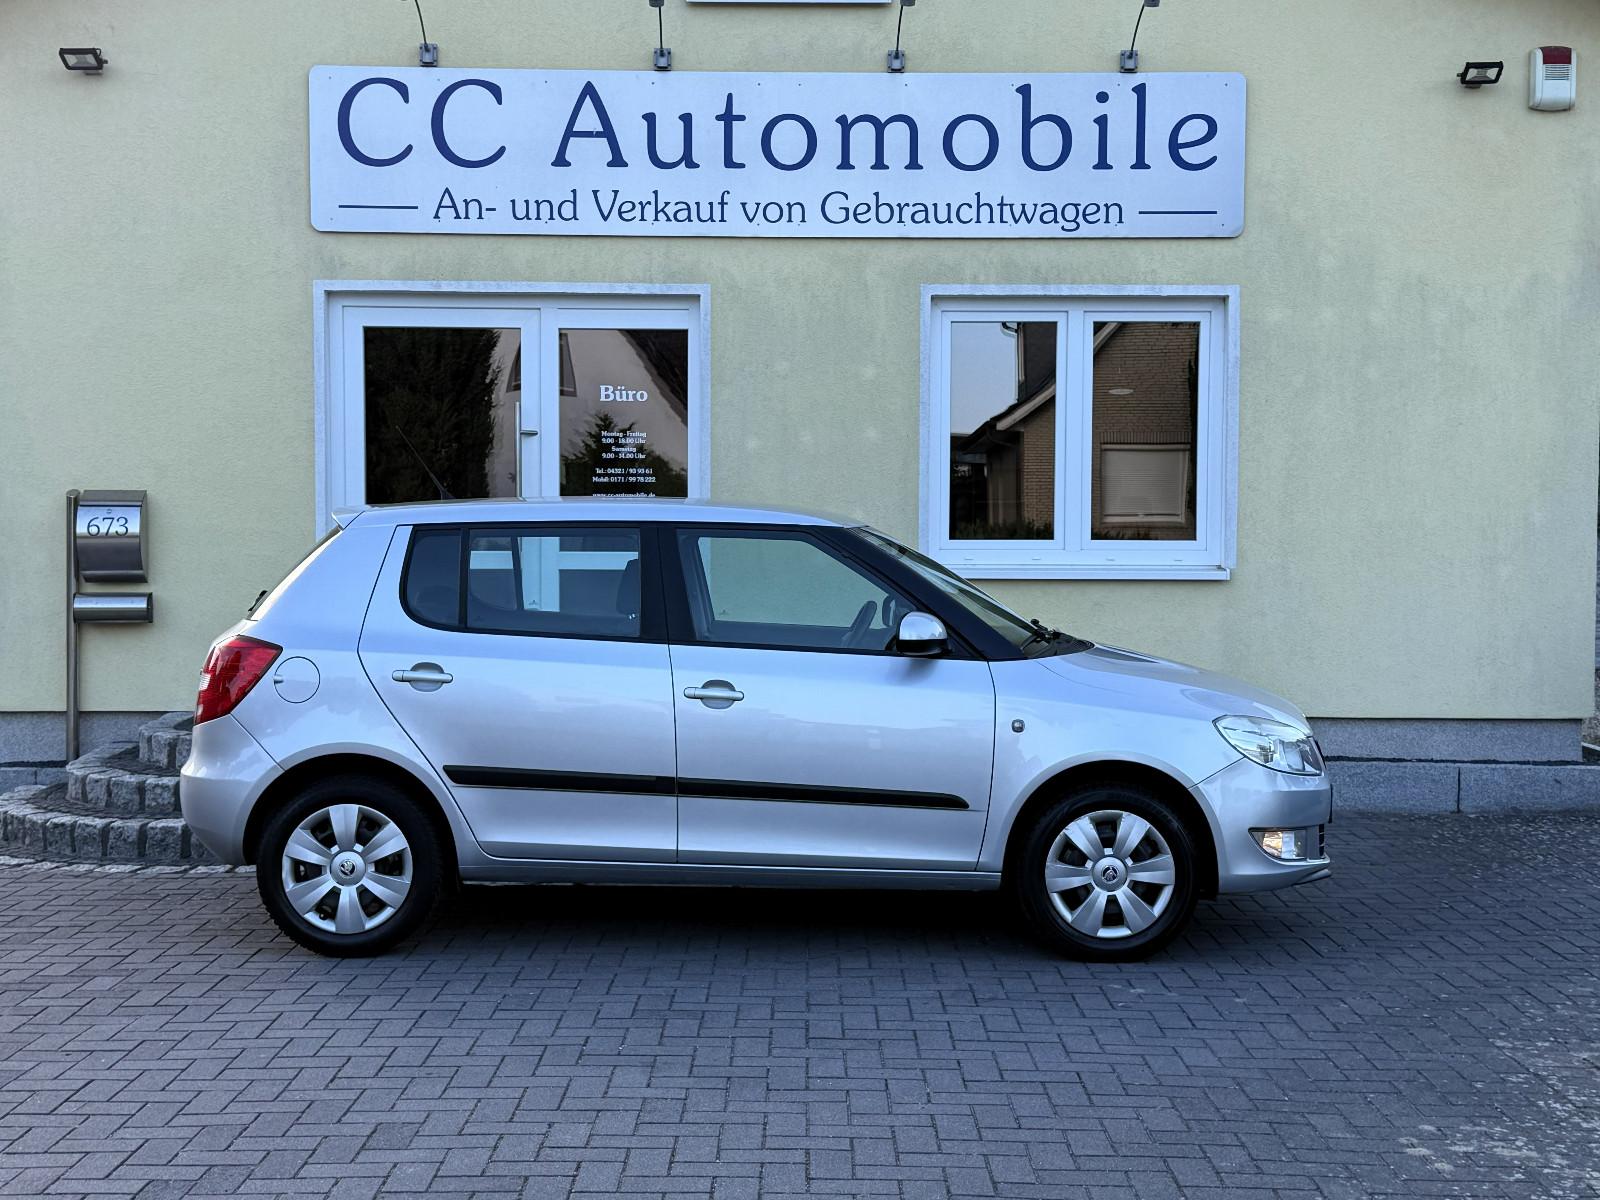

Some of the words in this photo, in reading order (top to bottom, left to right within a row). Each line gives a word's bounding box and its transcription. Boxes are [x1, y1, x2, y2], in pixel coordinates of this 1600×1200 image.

[337, 77, 507, 169] CC
[550, 80, 1218, 172] Automobile
[432, 187, 497, 220] An-
[510, 189, 580, 222] und
[591, 190, 731, 224] Verkauf
[739, 201, 807, 224] von
[820, 191, 1125, 233] Gebrauchtwagen
[599, 385, 648, 402] Büro
[86, 516, 129, 537] 673
